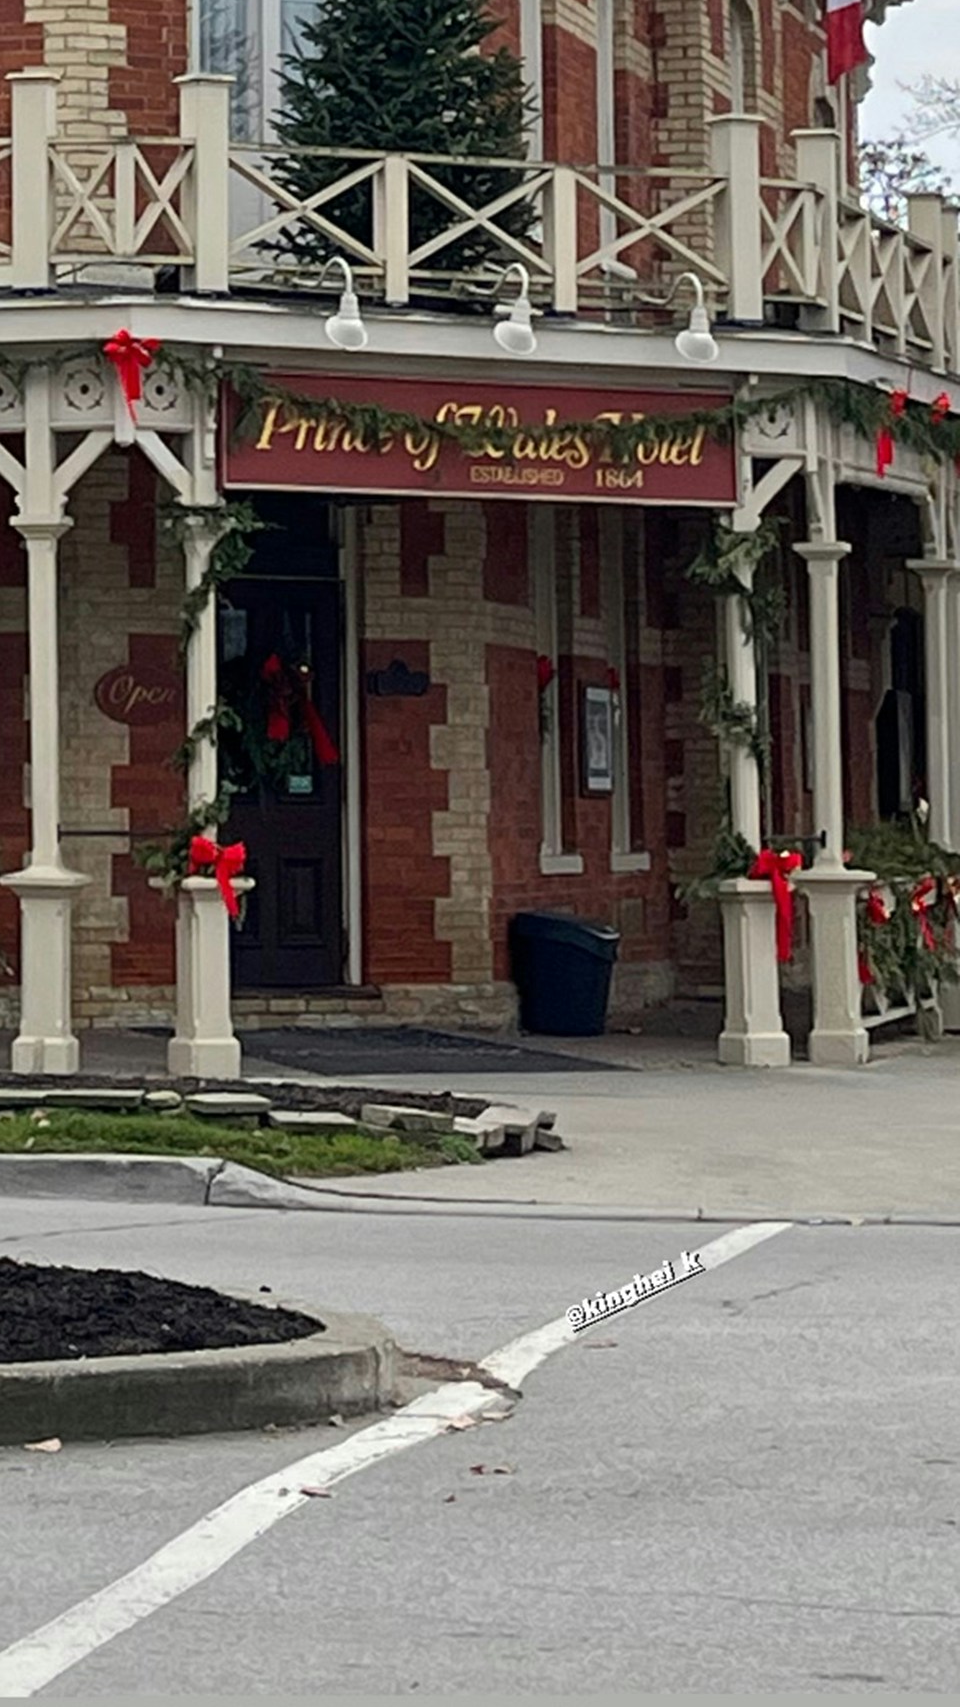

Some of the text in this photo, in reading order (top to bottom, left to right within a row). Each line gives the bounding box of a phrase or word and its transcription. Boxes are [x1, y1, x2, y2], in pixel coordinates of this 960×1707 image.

[469, 465, 644, 489] ESTABLISHED 1864
[108, 675, 177, 714] Open
